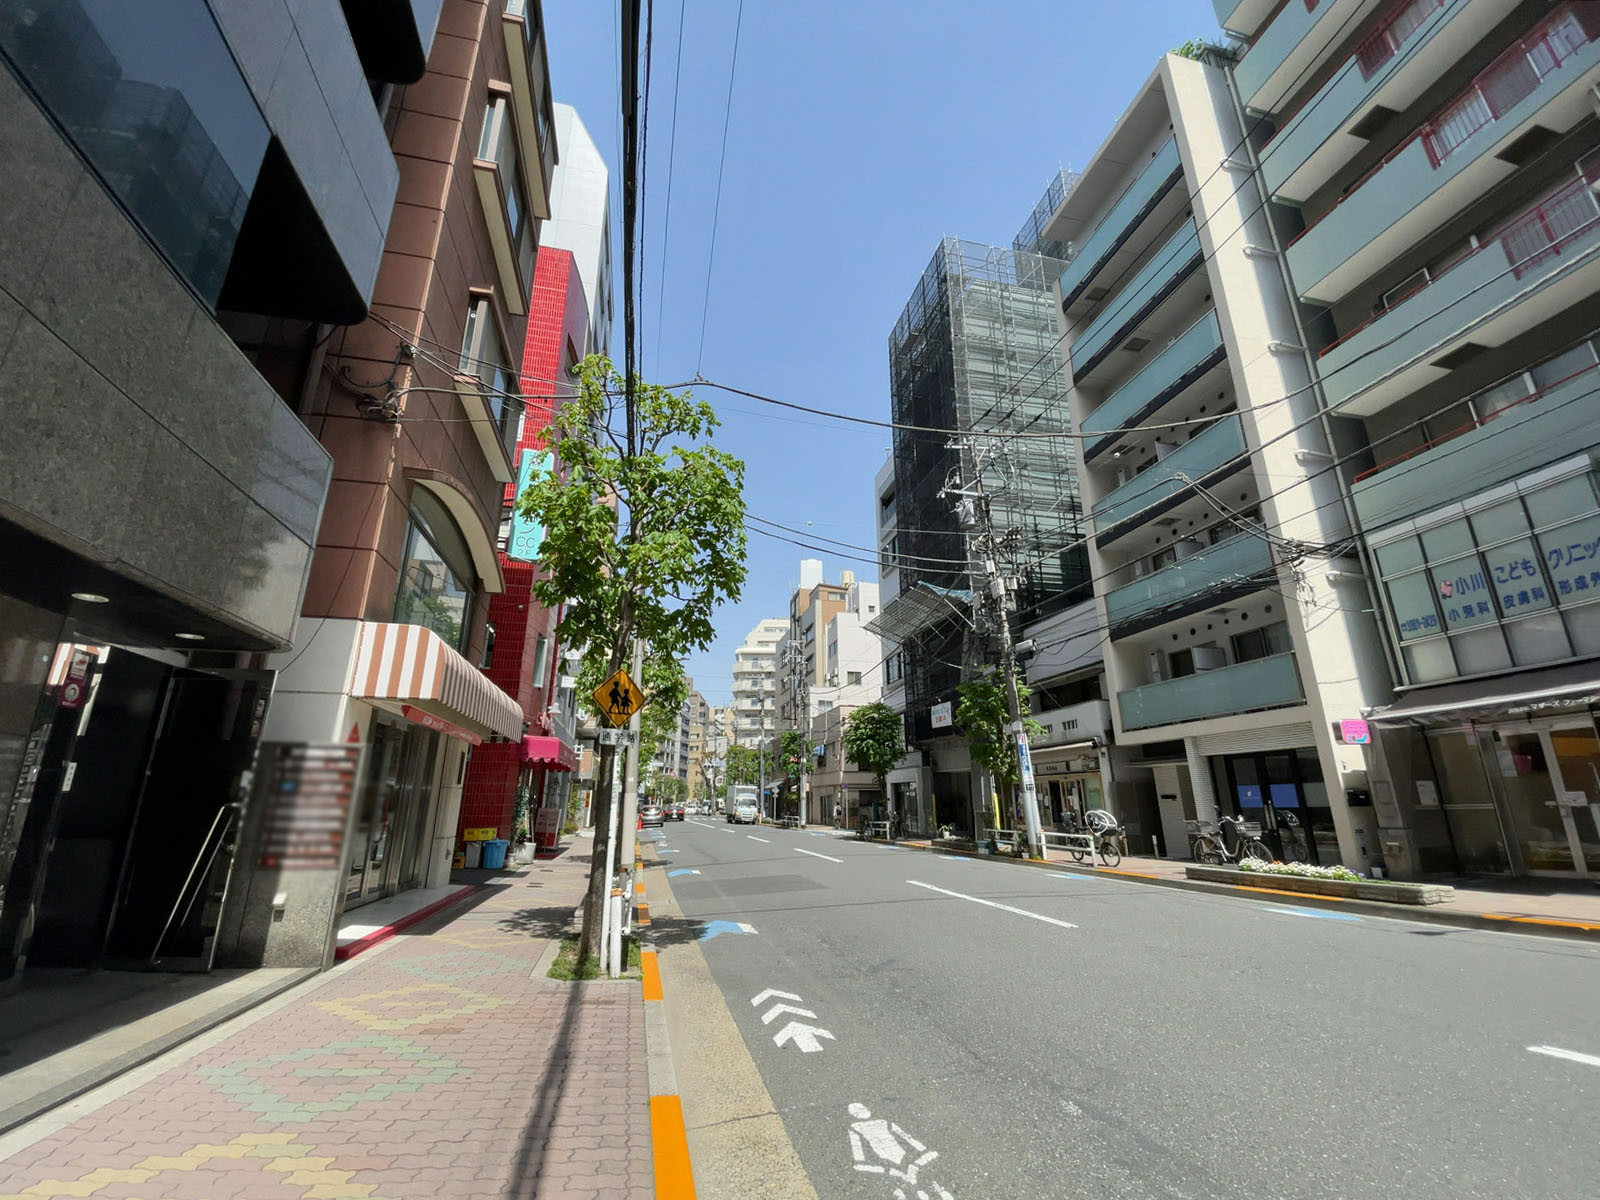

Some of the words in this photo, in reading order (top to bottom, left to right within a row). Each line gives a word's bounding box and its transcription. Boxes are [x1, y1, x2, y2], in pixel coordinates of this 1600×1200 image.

[1455, 571, 1486, 596] 小川
[1494, 558, 1537, 585] こども
[1448, 601, 1491, 623] 小児科
[1502, 586, 1545, 609] 皮膚科
